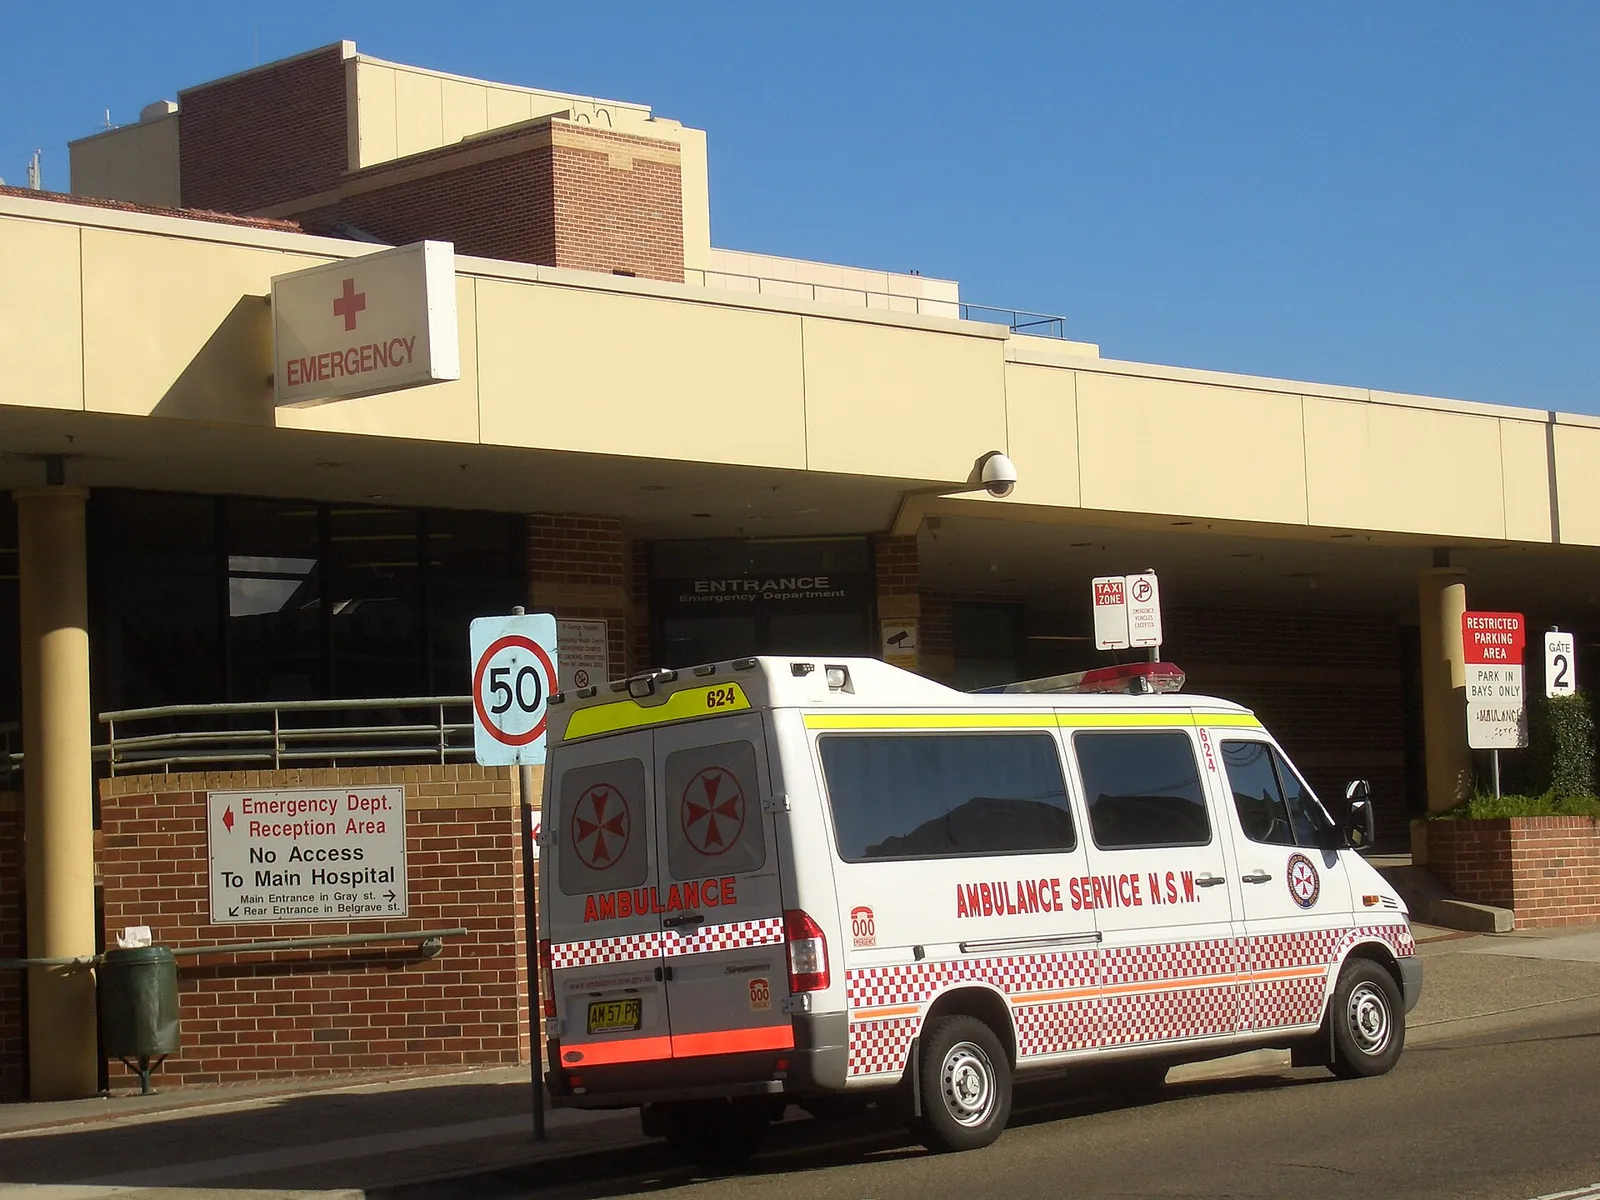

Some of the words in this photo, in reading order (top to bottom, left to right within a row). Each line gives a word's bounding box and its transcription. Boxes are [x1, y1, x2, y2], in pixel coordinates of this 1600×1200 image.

[287, 335, 416, 387] EMERGENCY
[694, 576, 830, 593] ENTRANCE
[1096, 583, 1122, 594] TAXI
[679, 593, 757, 603] Emergency
[764, 589, 845, 600] Department
[1099, 594, 1121, 605] ZONE
[1467, 617, 1519, 630] RESTRICTED
[1474, 632, 1513, 645] PARKING
[1483, 647, 1507, 659] AREA
[1548, 642, 1571, 653] GATE
[1478, 670, 1500, 682] PARK
[1505, 671, 1514, 682] IN
[1553, 654, 1569, 688] 2
[490, 665, 542, 714] 50
[706, 687, 736, 708] 624
[1472, 685, 1493, 697] BAYS
[1499, 685, 1521, 697] ONLY
[1199, 727, 1216, 773] 624
[242, 797, 338, 817] Emergency
[347, 794, 392, 816] Dept.
[249, 819, 336, 840] Reception
[345, 818, 386, 834] Area
[250, 847, 277, 864] No
[288, 846, 364, 862] Access
[221, 871, 244, 888] To
[255, 870, 301, 887] Main
[311, 866, 395, 888] Hospital
[240, 894, 264, 904] Main
[268, 893, 315, 903] Entrance
[319, 892, 329, 901] in
[333, 892, 358, 902] Gray
[363, 891, 376, 900] st.
[583, 876, 737, 923] AMBULANCE
[956, 878, 1064, 919] AMBULANCE
[1069, 873, 1143, 911] SERVICE
[1147, 871, 1201, 905] N.S.W.
[244, 906, 268, 916] Rear
[273, 905, 319, 915] Entrance
[324, 904, 333, 913] in
[337, 903, 382, 914] Belgrave
[387, 902, 401, 911] st.
[852, 918, 875, 937] 000
[750, 988, 769, 1002] 000
[608, 1004, 622, 1021] 57
